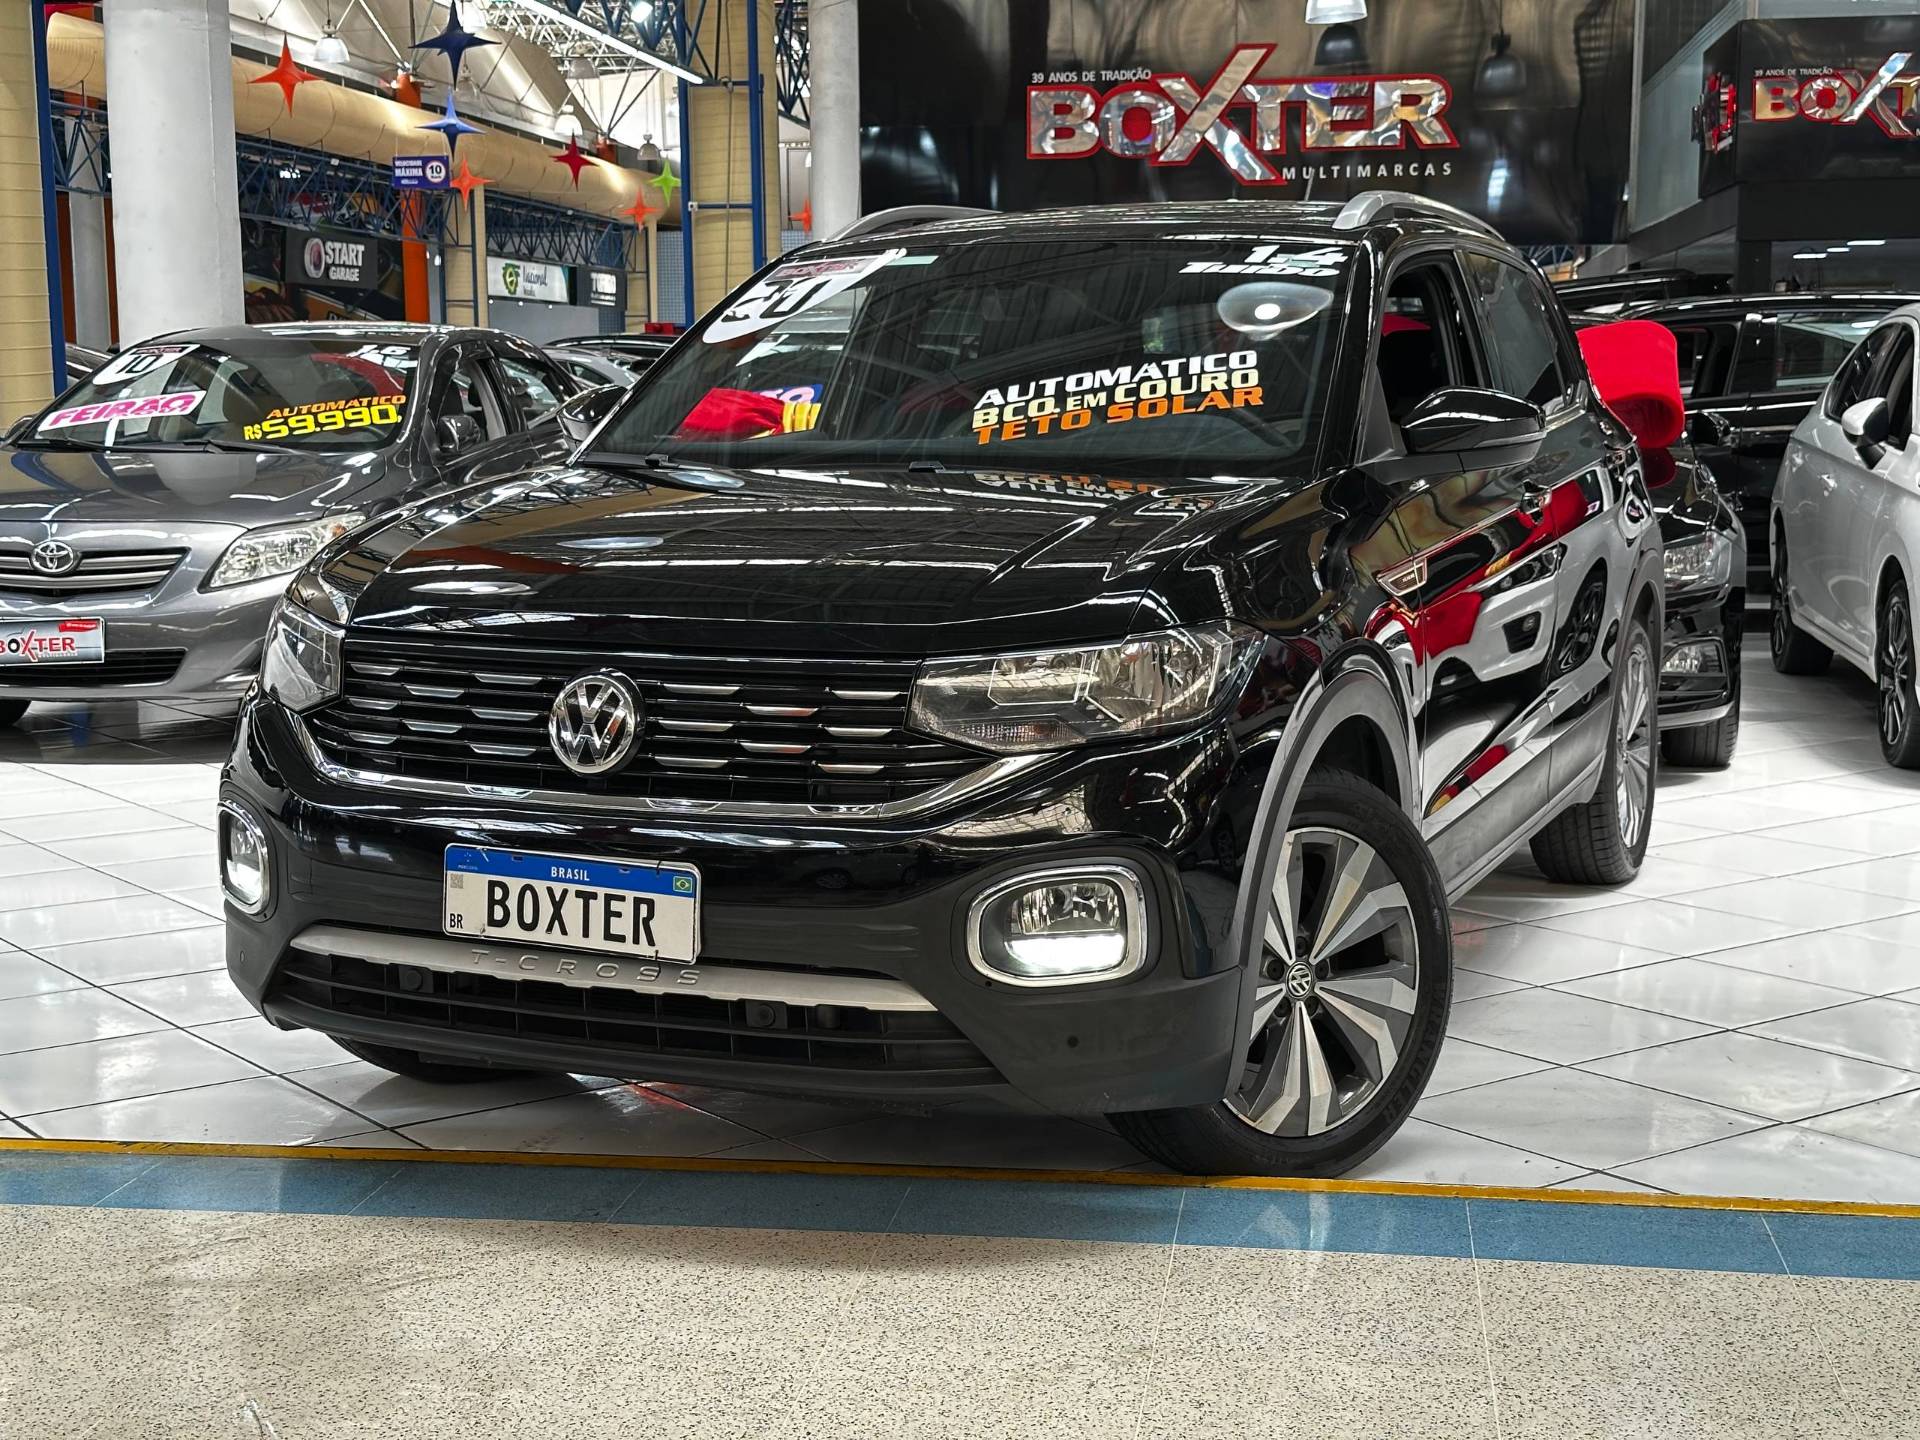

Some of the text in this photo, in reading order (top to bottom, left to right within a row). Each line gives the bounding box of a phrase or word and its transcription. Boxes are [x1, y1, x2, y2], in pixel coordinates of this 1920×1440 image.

[1032, 67, 1152, 83] 39 ANOS DE TRADIÇÃO
[1027, 43, 1461, 185] BOXTER
[429, 164, 442, 175] 10
[1282, 161, 1454, 181] MULTIMARCAS
[325, 241, 365, 267] START
[329, 266, 359, 282] GARAGE
[1066, 391, 1107, 412] EM
[1114, 368, 1259, 404] COURO
[972, 386, 1264, 445] TETO SOLAR
[551, 866, 590, 882] BRASIL
[449, 912, 464, 929] BR
[487, 879, 656, 947] BOXTER
[471, 948, 701, 986] T-CROSS
